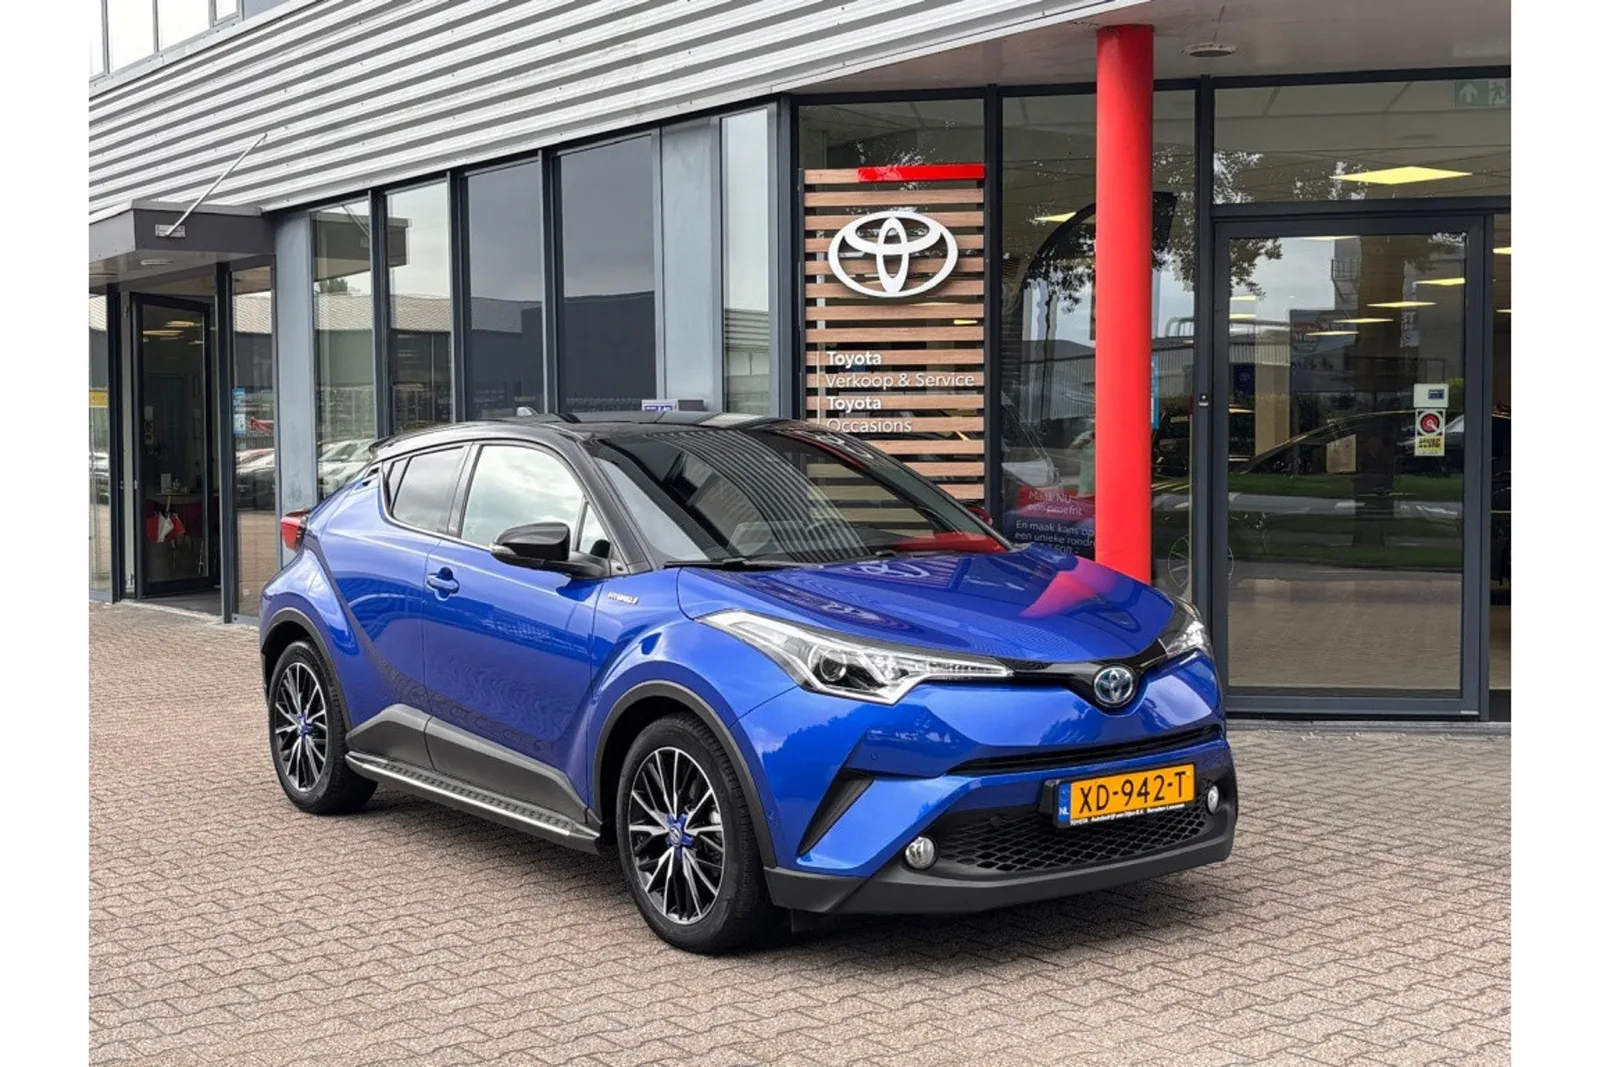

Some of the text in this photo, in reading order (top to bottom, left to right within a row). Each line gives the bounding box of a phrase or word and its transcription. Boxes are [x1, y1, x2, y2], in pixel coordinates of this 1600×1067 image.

[827, 351, 882, 368] Toyota
[826, 372, 975, 390] Verkoop & Service
[827, 396, 882, 413] Toyota
[827, 418, 912, 432] Occasions
[1016, 520, 1028, 529] En
[1030, 523, 1055, 532] maak
[1058, 524, 1079, 534] kans
[1015, 532, 1033, 540] een
[1034, 533, 1065, 544] unieke
[1079, 771, 1186, 813] XD-942-T
[1059, 806, 1069, 815] NL
